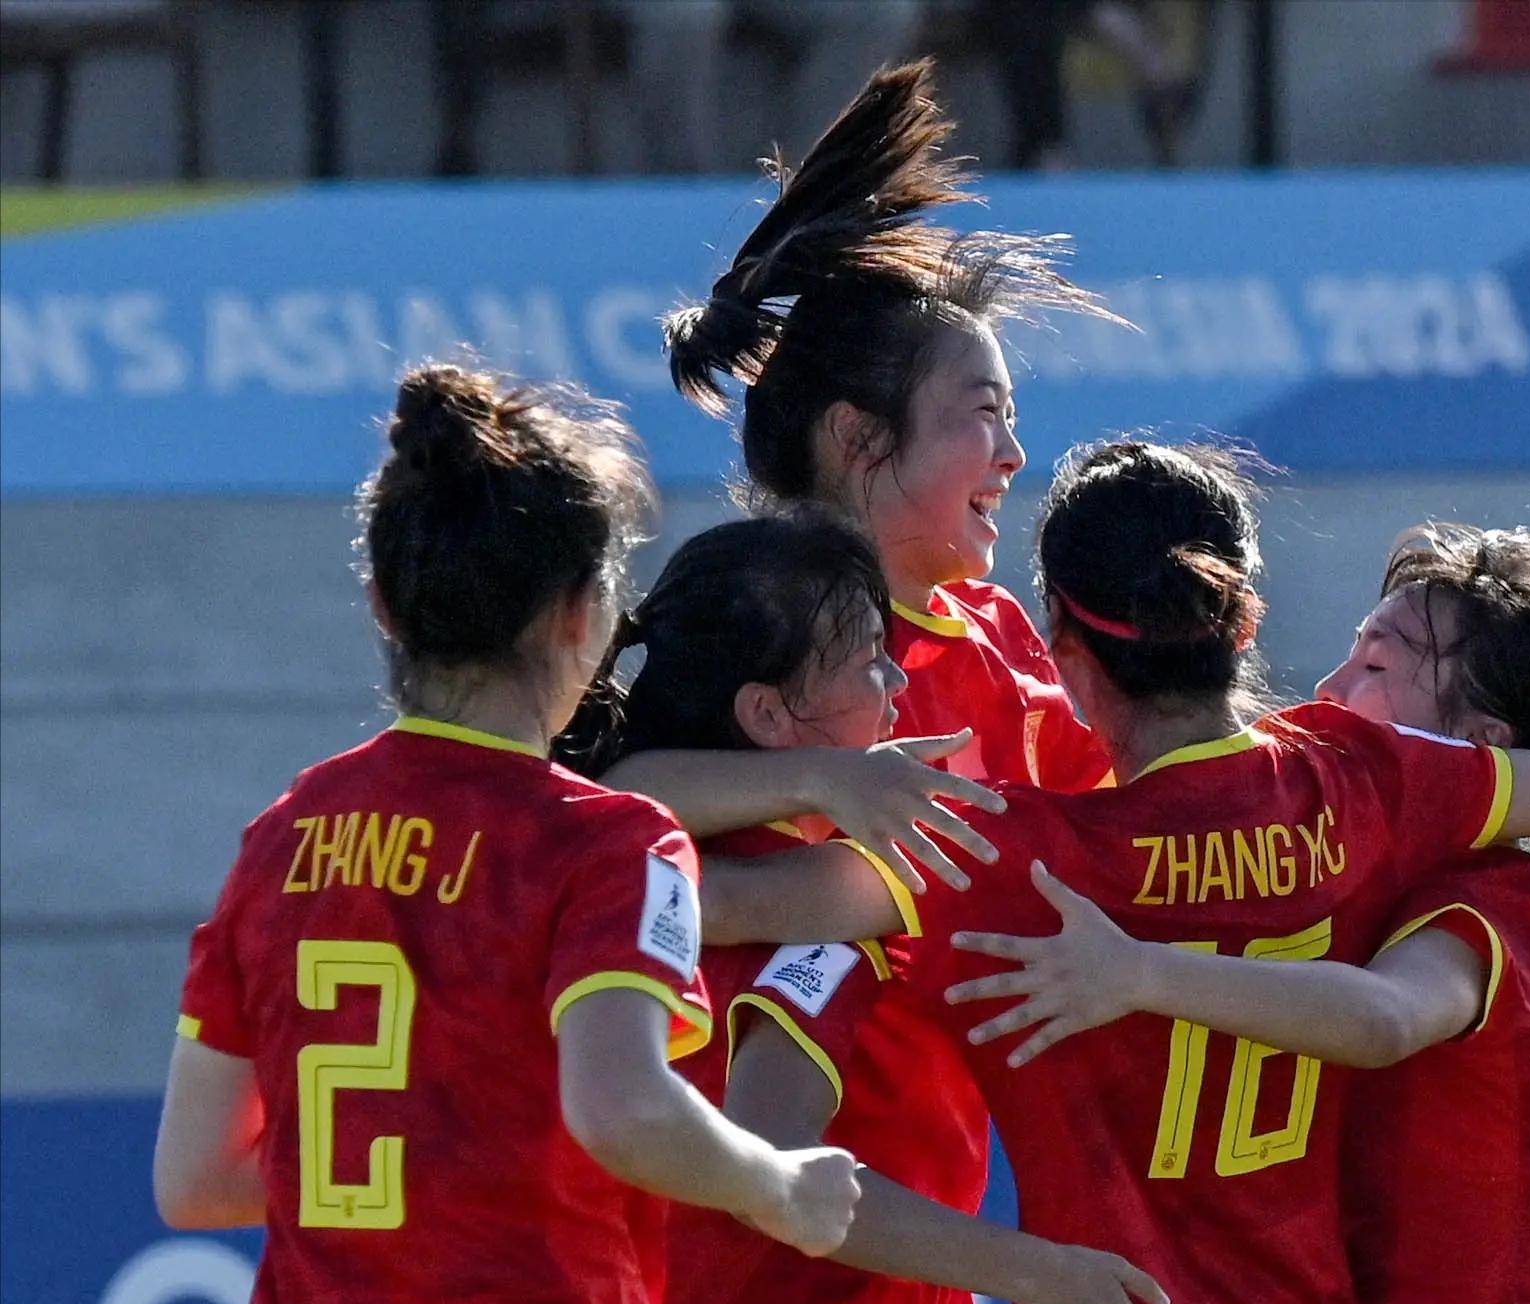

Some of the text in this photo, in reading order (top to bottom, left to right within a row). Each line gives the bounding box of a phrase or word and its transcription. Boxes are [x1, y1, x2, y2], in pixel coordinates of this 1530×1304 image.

[282, 812, 481, 904] ZHANG J
[1132, 824, 1296, 905] ZHANG
[298, 939, 417, 1229] 2
